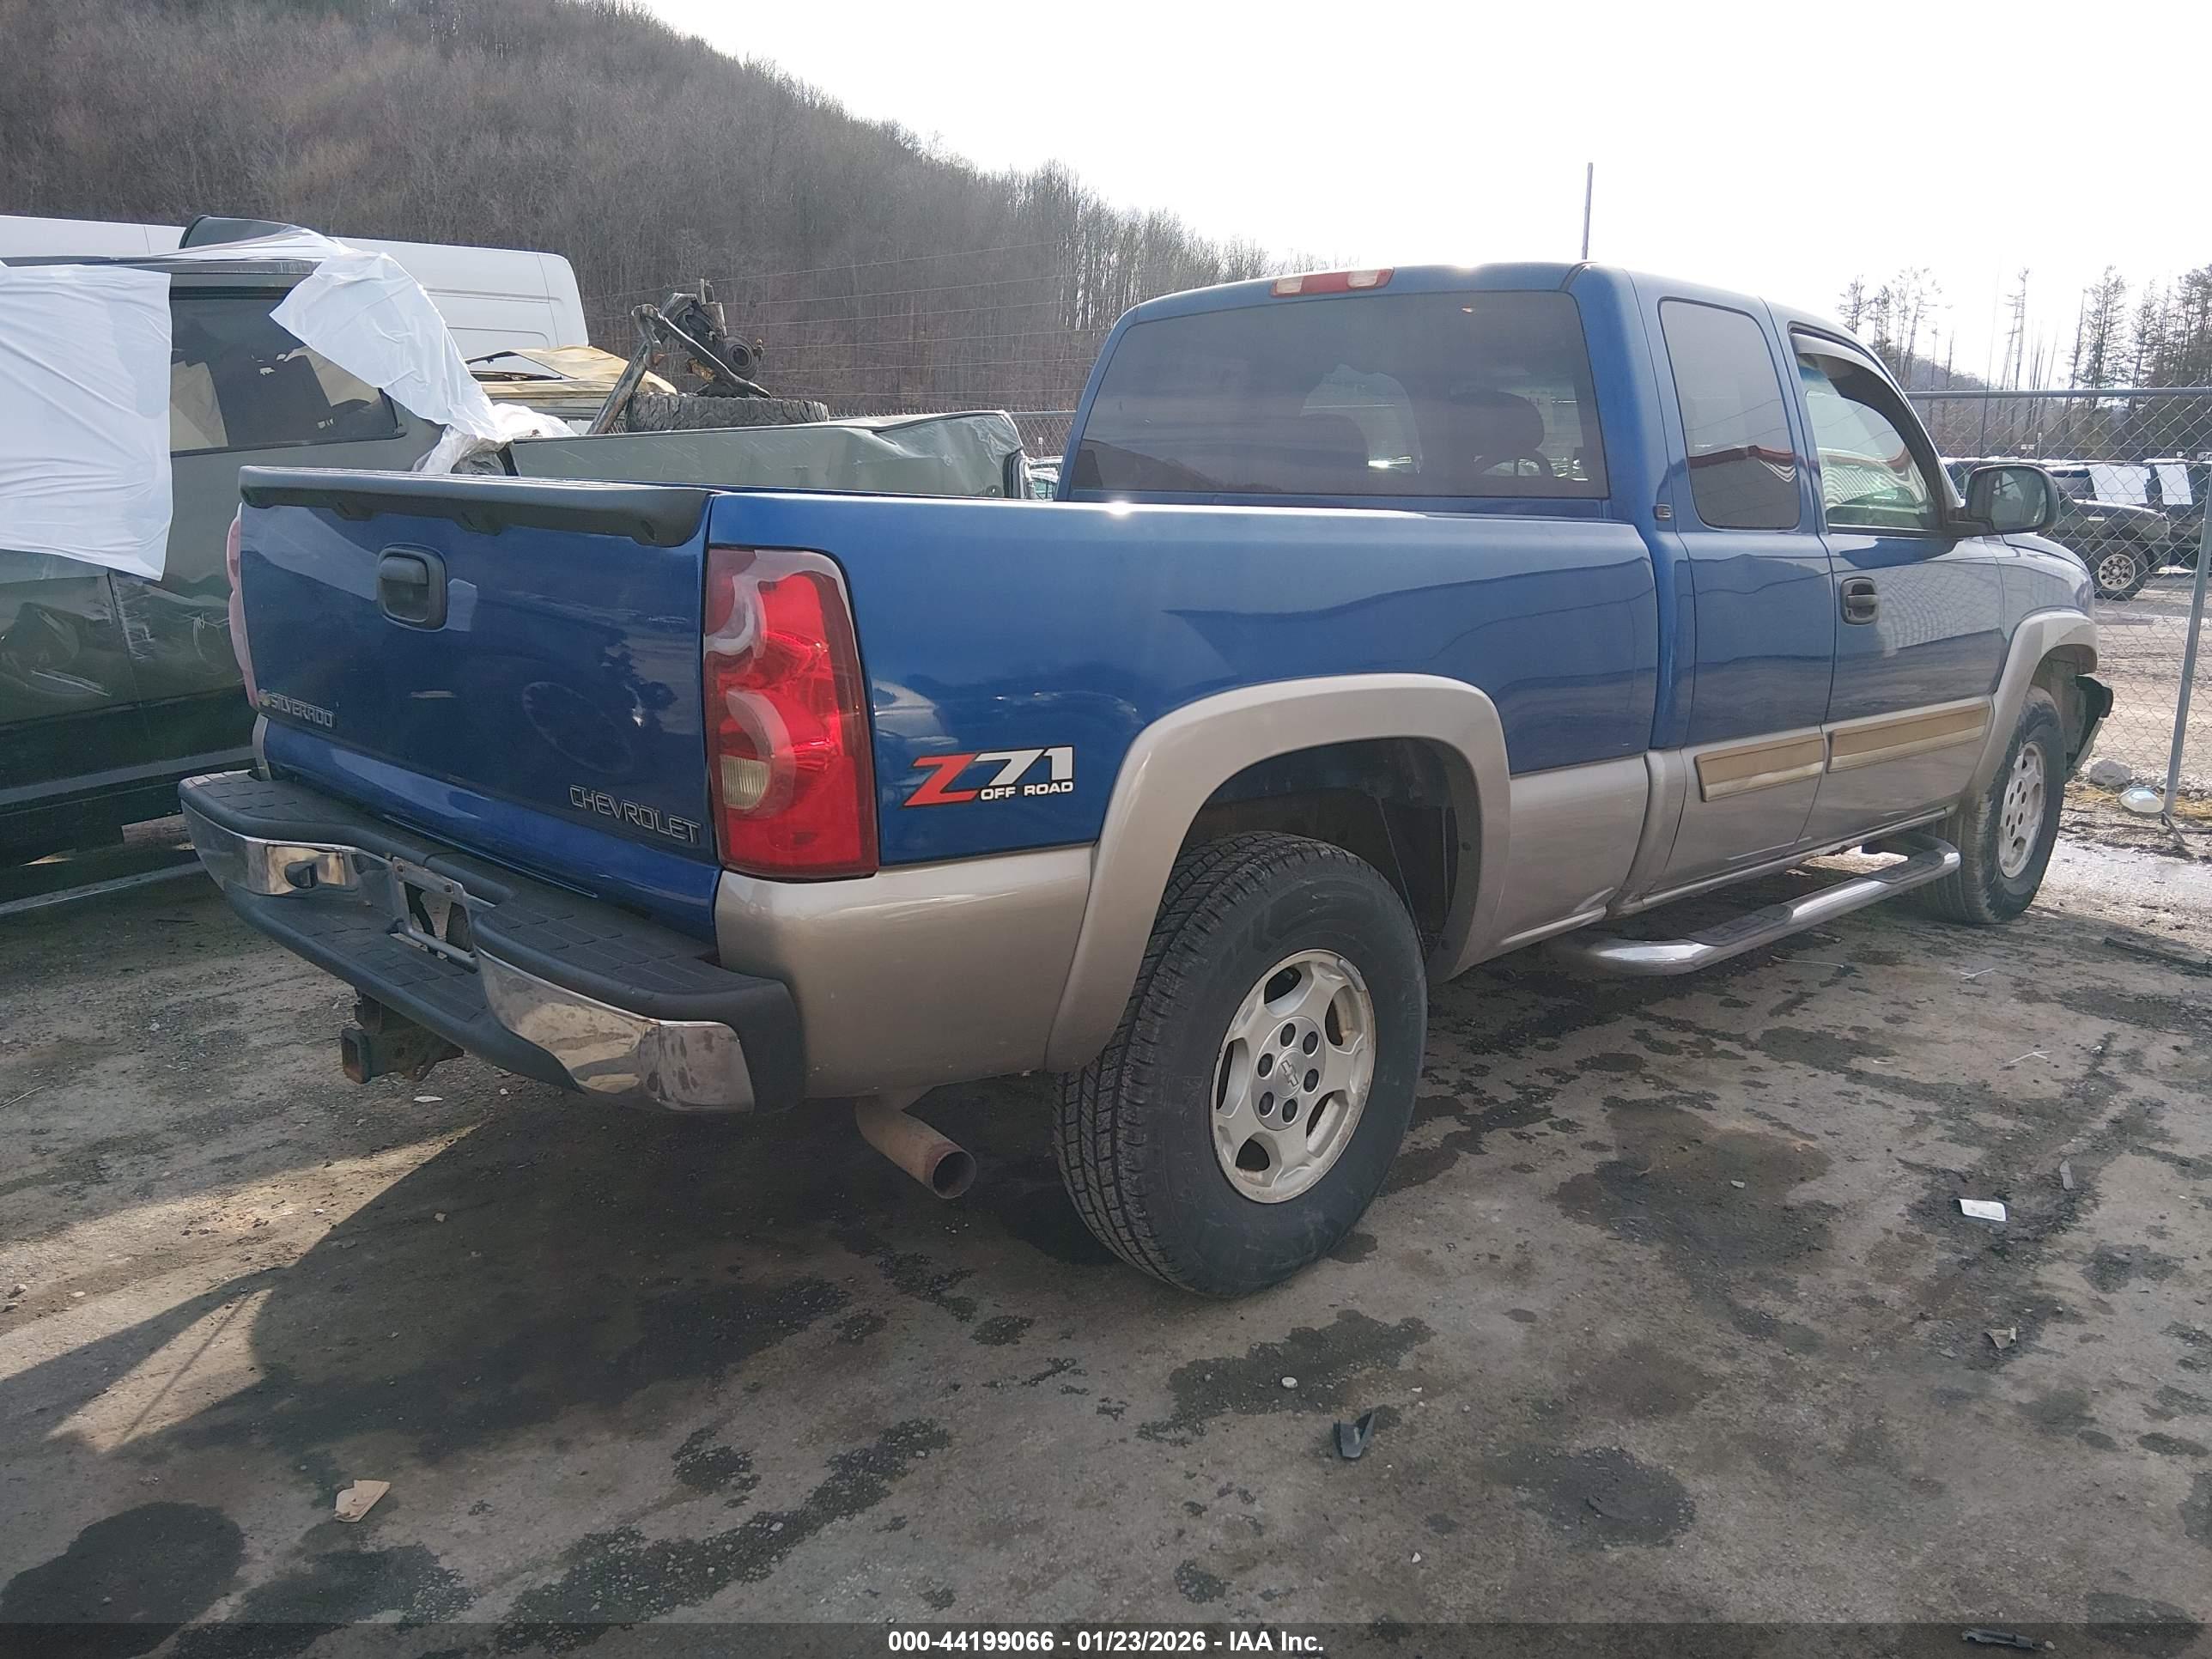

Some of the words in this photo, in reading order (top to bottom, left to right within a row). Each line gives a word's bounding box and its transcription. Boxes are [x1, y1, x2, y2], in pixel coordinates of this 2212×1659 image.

[269, 693, 333, 728] SILVERADO
[903, 746, 1073, 807] Z71
[980, 786, 1016, 801] OFF
[1023, 781, 1073, 797] ROAD
[569, 785, 701, 843] CHEVROLET
